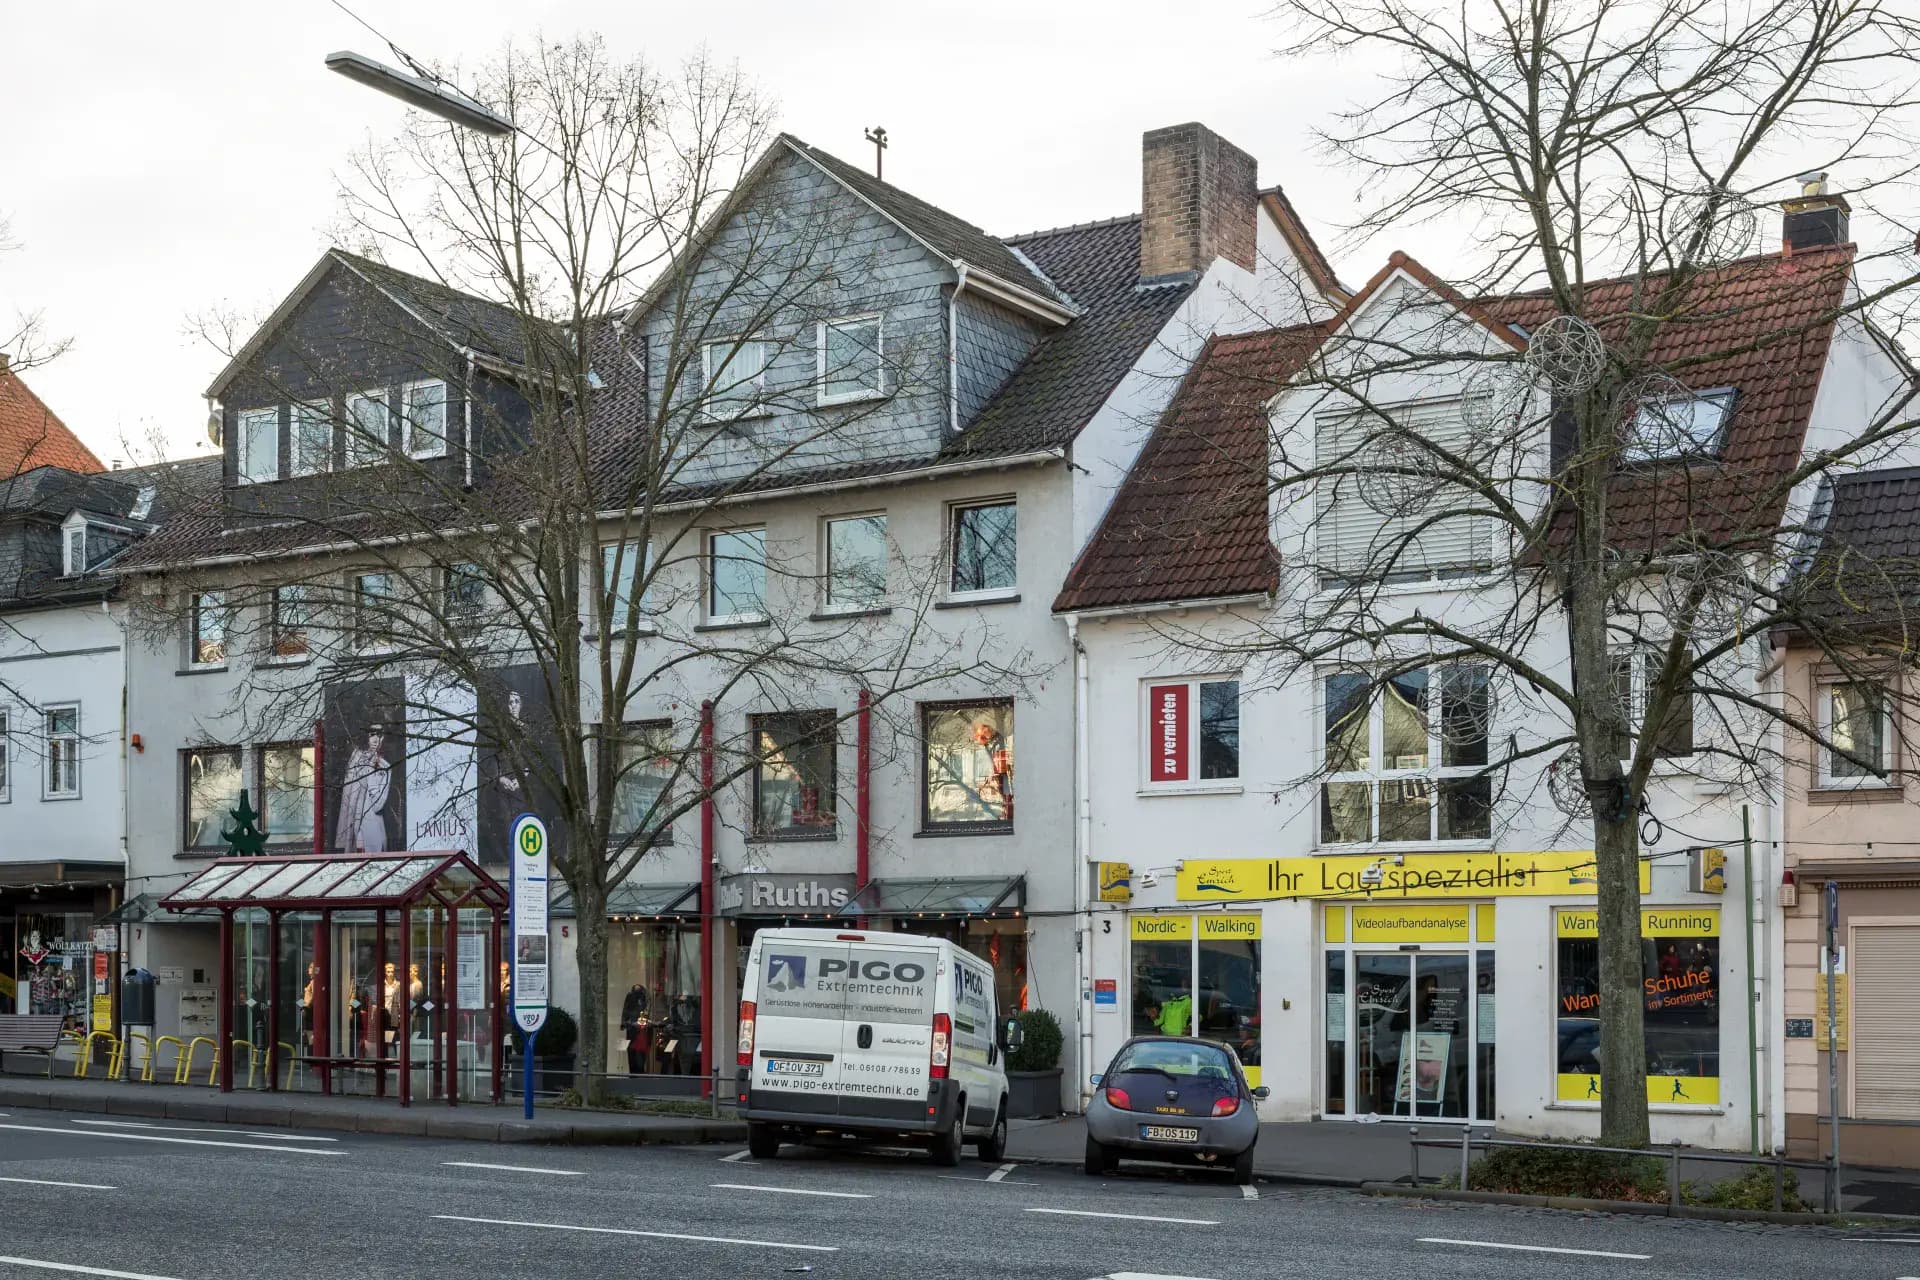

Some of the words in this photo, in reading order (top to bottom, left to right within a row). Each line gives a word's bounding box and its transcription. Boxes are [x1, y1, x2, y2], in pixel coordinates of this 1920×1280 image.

[1159, 693, 1177, 756] vermieten
[1164, 758, 1177, 774] zu
[416, 818, 467, 838] LANIUS
[525, 831, 537, 850] H
[1268, 860, 1304, 891] Ihr
[752, 881, 849, 907] Ruths
[562, 926, 570, 938] 5
[1103, 920, 1112, 934] 3
[1137, 920, 1177, 933] Nordic
[1205, 919, 1256, 936] Walking
[1356, 917, 1467, 932] Videolaufbandanalyse
[1648, 915, 1712, 932] Running
[818, 958, 925, 983] PIGO
[817, 980, 924, 997] Extremtechnik
[963, 969, 983, 996] PIGO
[1644, 969, 1712, 995] Schuhe
[1664, 988, 1714, 1008] Sortiment
[805, 1065, 821, 1074] 371
[843, 1062, 858, 1071] Tel.
[761, 1076, 920, 1097] www.pigo-extremtechnik.de
[1147, 1127, 1159, 1137] FB
[1165, 1129, 1178, 1139] OS
[1180, 1130, 1197, 1140] 119
